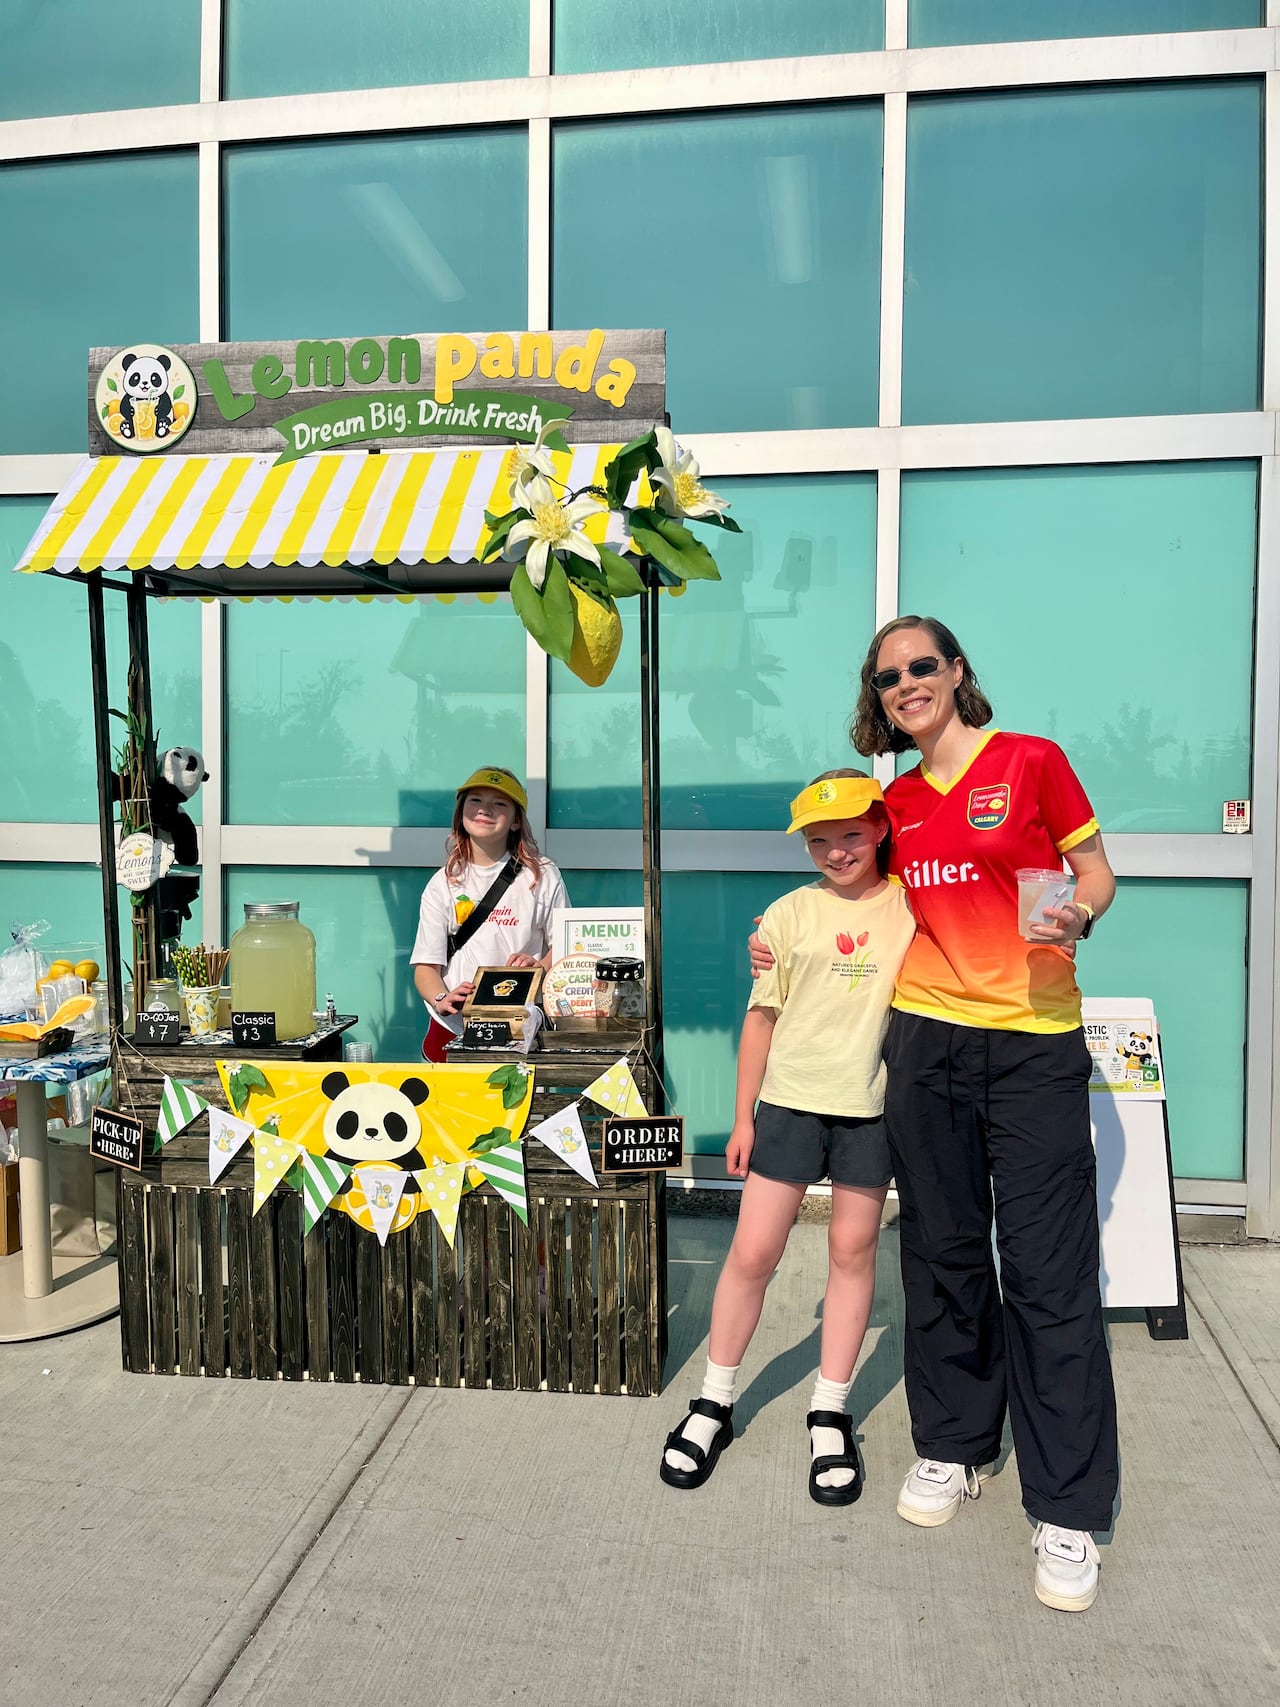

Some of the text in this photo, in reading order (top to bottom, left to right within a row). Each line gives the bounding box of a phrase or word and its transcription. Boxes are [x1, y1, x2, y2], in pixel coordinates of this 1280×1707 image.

[202, 328, 637, 421] Lemon panda
[292, 400, 543, 451] Dream Big. Drink Fresh
[117, 853, 162, 871] Lemons
[903, 858, 980, 889] tiller.
[581, 923, 631, 938] MENU
[562, 961, 575, 969] WE
[568, 974, 593, 984] CASH
[565, 986, 595, 996] CREDIT
[570, 999, 593, 1007] DEBIT
[232, 1014, 275, 1026] Classic
[93, 1116, 141, 1146] PICK-UP
[607, 1126, 681, 1146] ORDER
